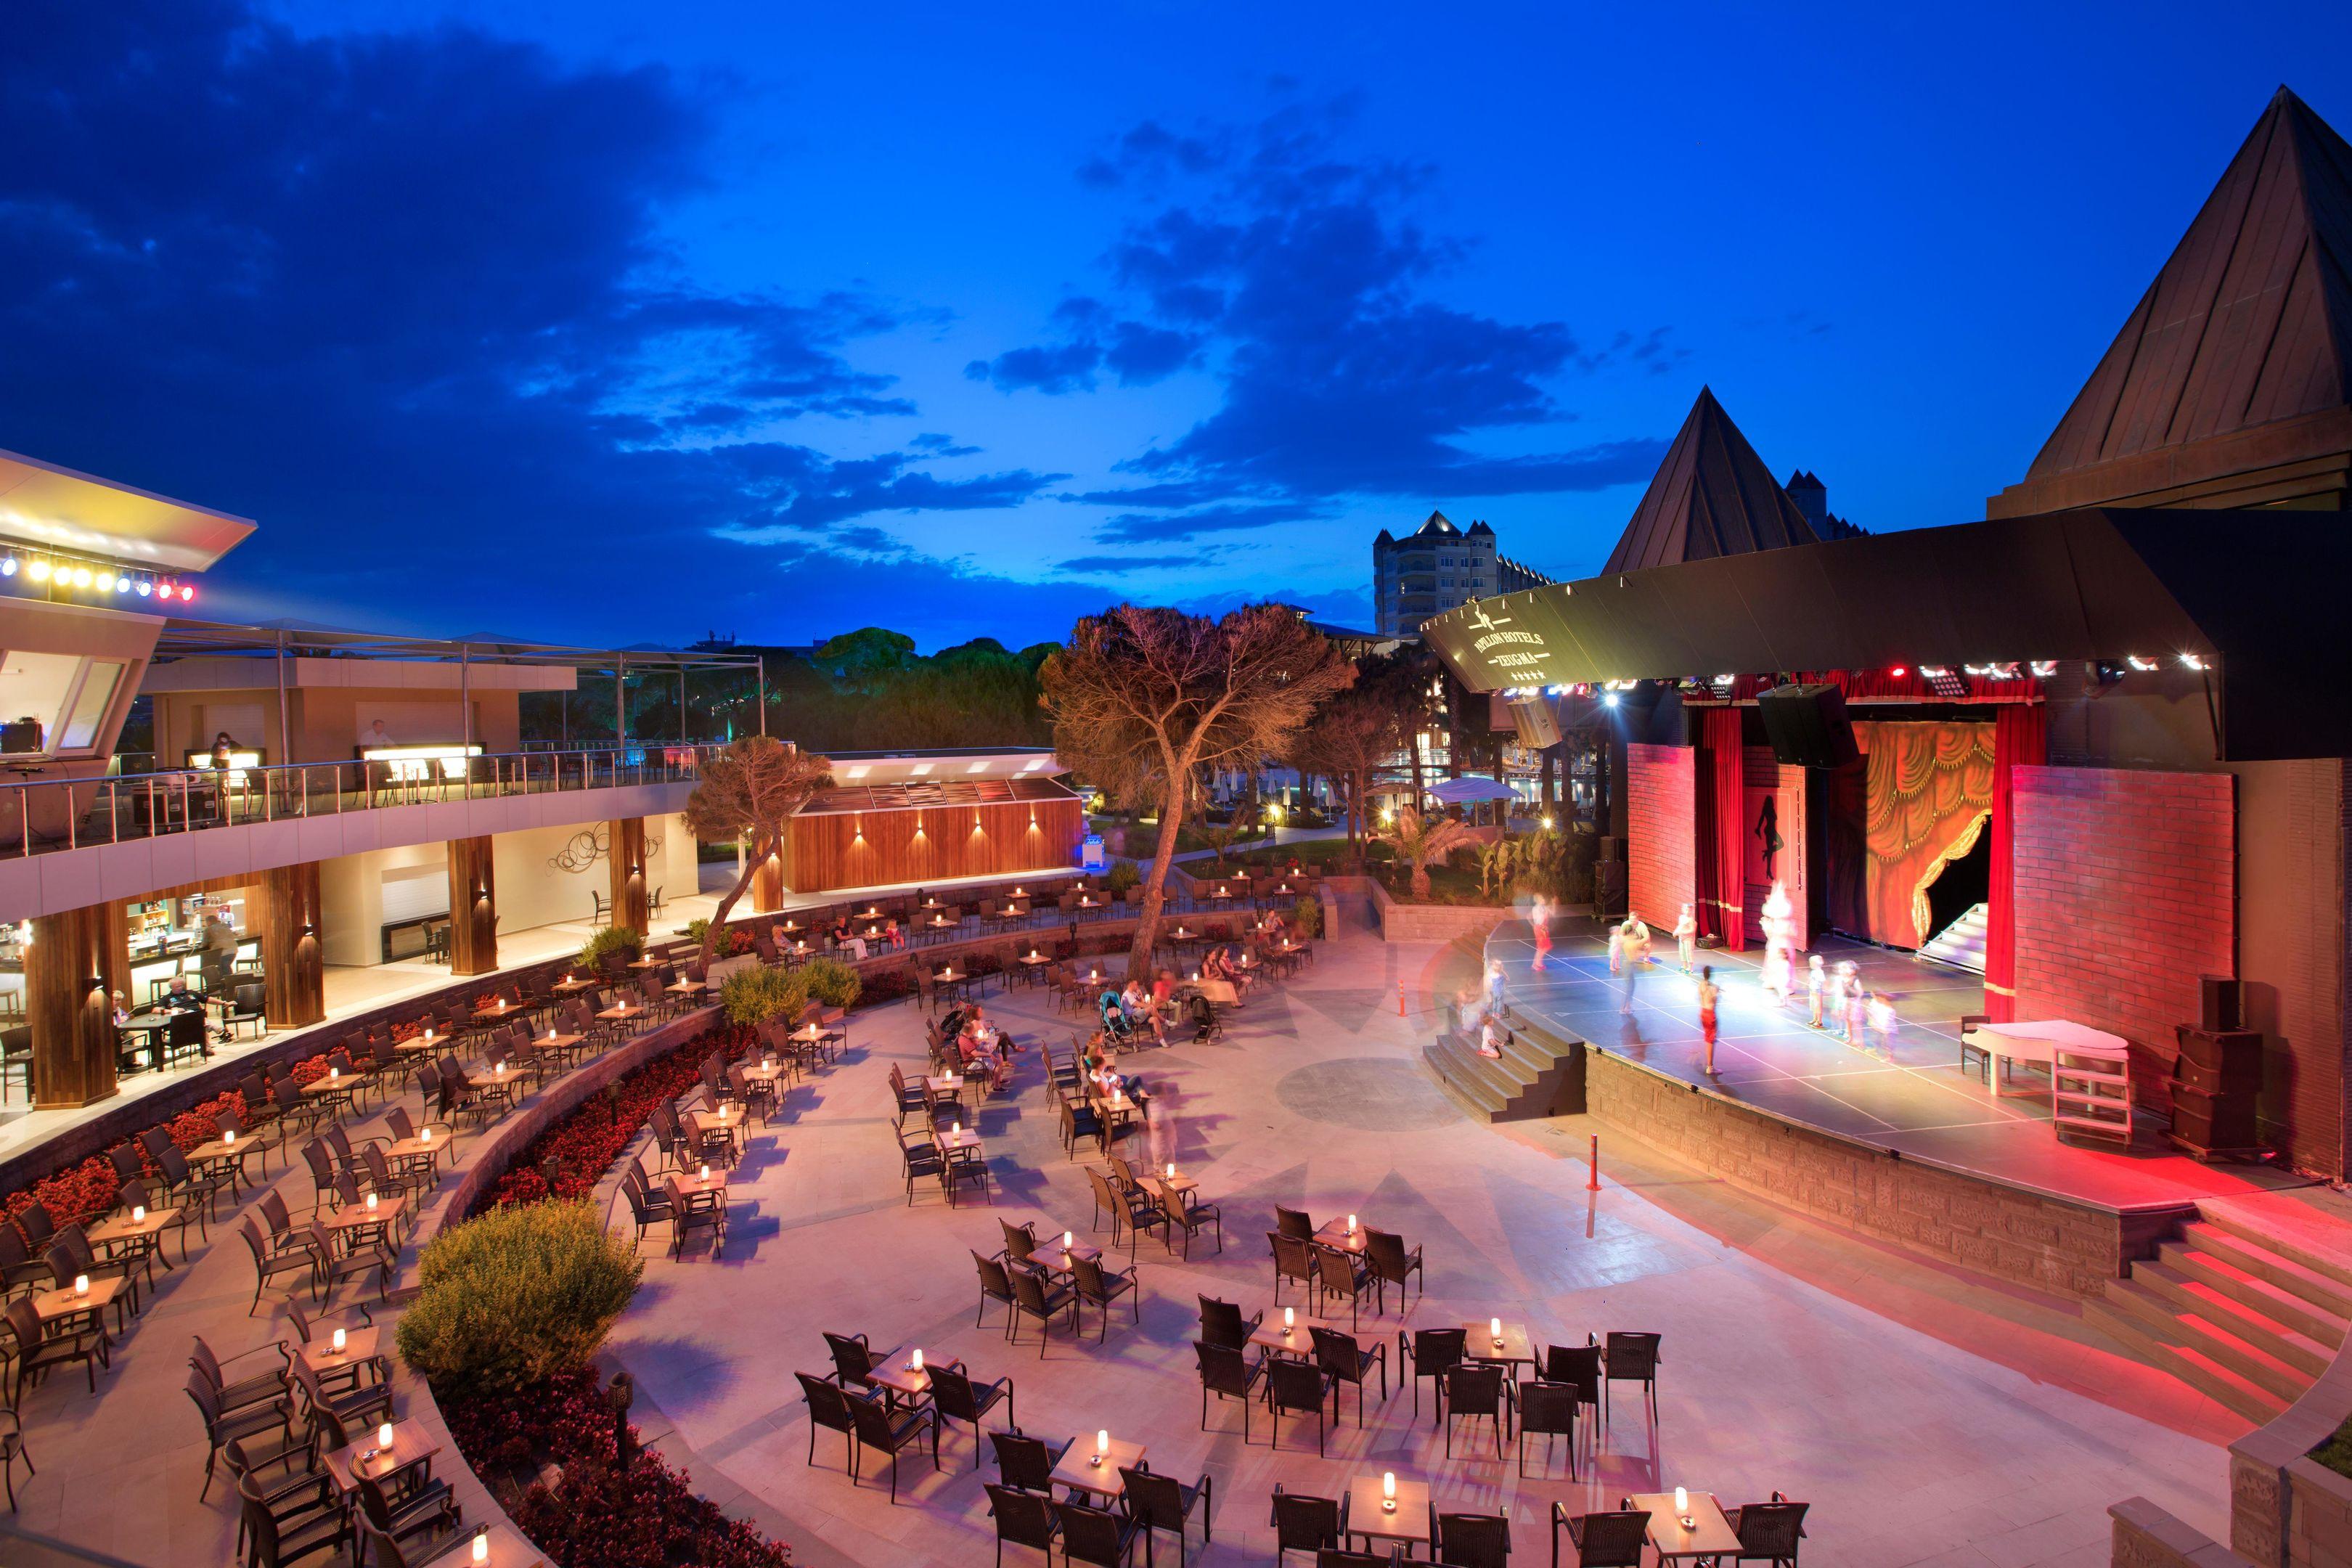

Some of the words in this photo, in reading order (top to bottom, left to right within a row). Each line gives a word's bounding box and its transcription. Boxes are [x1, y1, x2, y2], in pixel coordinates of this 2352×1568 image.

[1474, 633, 1505, 653] PAPILLON
[1500, 632, 1544, 645] HOTELS
[1495, 652, 1538, 666] ZEUGMA
